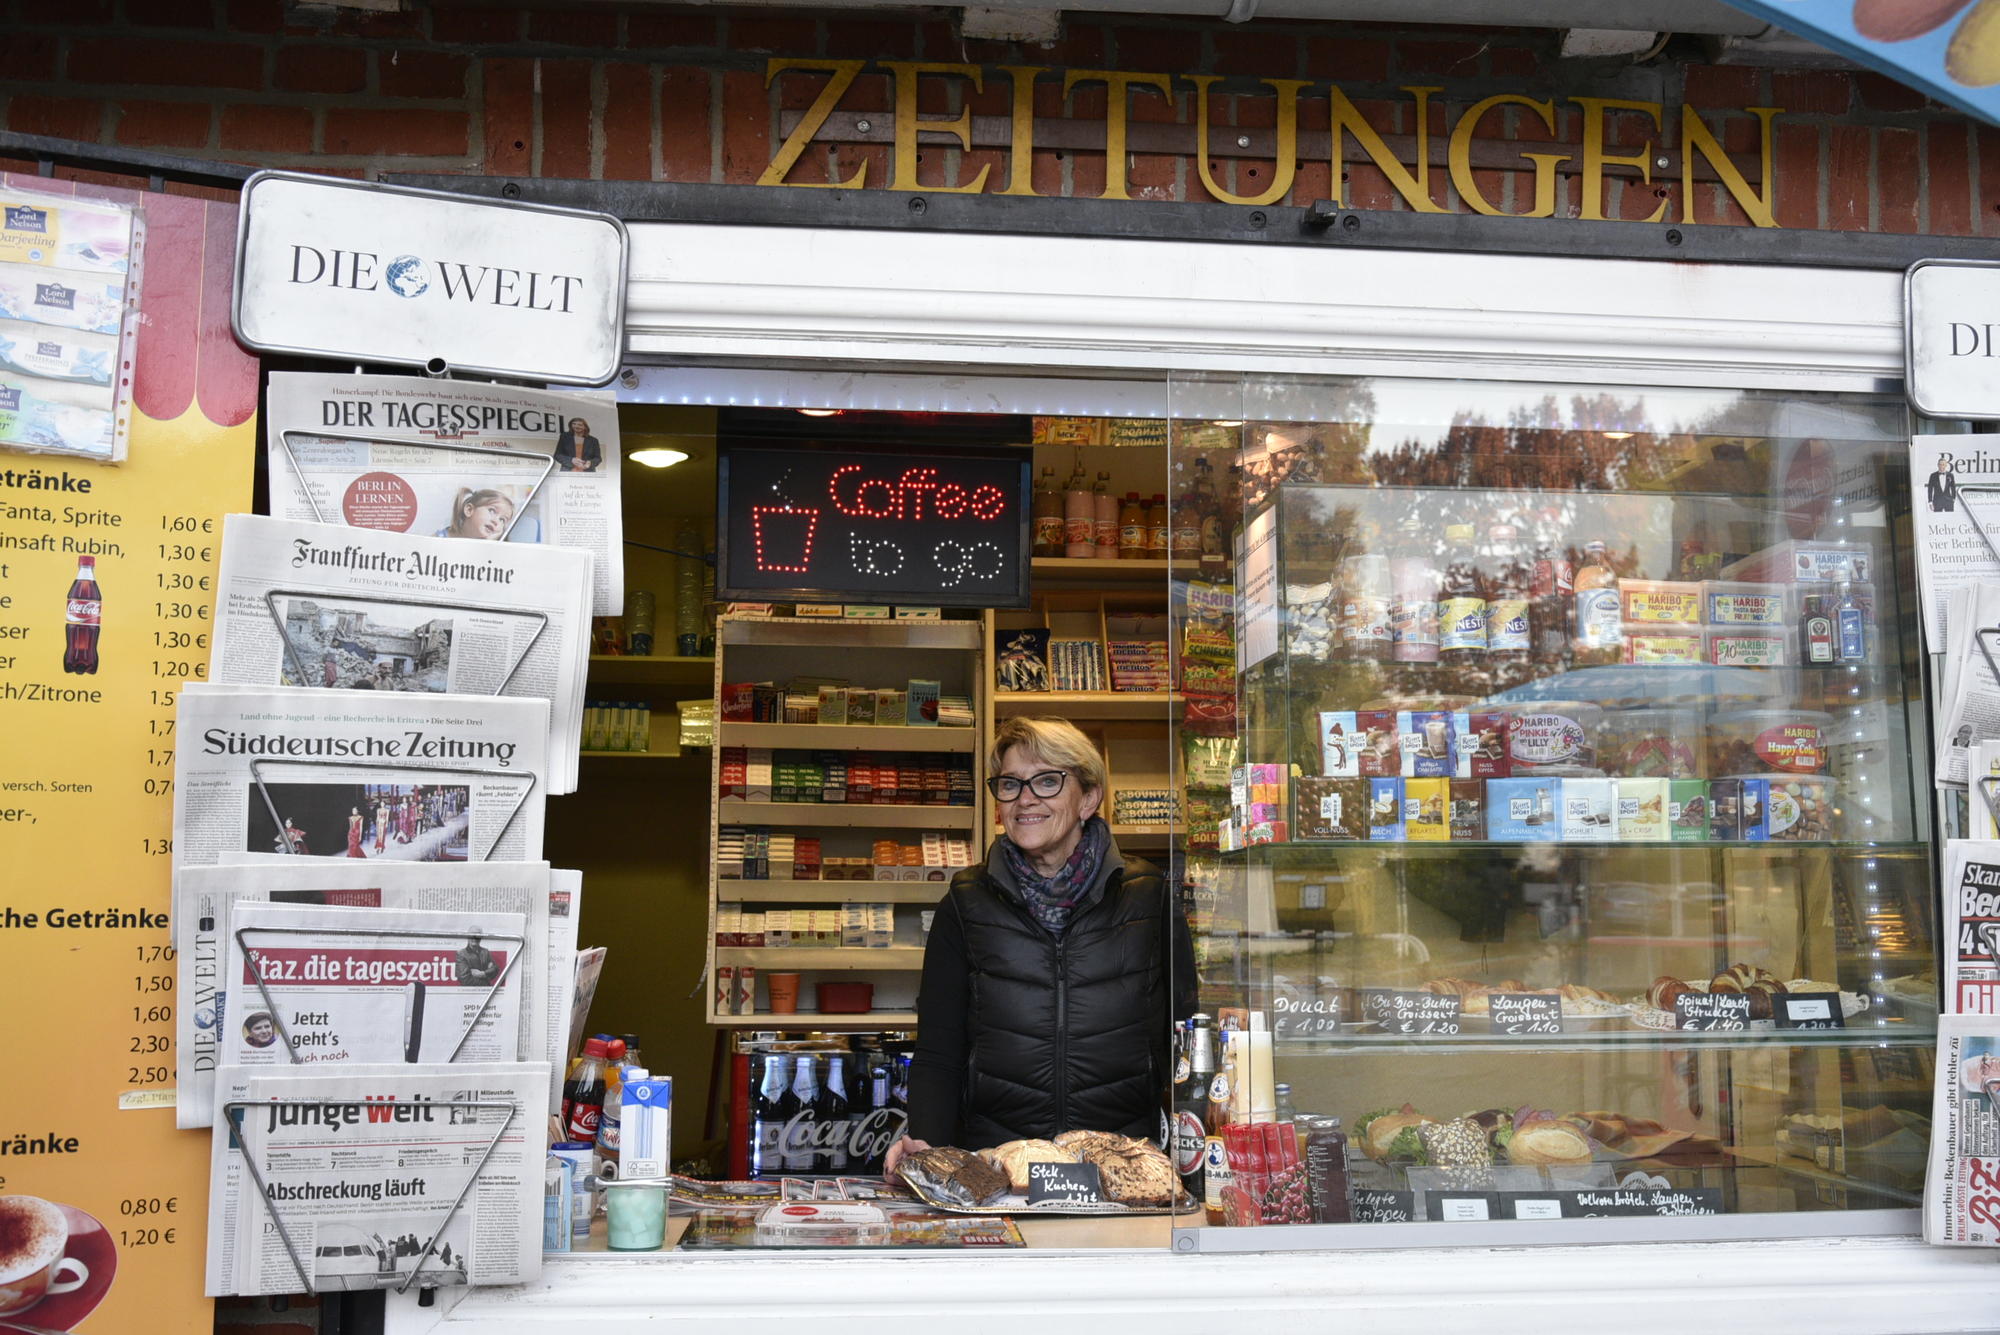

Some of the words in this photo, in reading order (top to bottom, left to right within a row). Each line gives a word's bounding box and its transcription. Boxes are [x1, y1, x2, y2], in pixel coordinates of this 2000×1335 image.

[757, 58, 1782, 229] ZEITUNGEN
[10, 219, 42, 229] Nelson
[15, 212, 37, 220] Lord
[288, 245, 378, 291] DIE
[435, 261, 583, 313] WELT
[40, 294, 70, 306] Nelson
[45, 288, 66, 298] Lord
[322, 400, 374, 427] DER
[382, 402, 566, 434] TAGESSPIEGEL
[358, 480, 401, 491] BERLIN
[829, 465, 1004, 520] Coffee
[355, 493, 404, 504] LERNEN
[63, 506, 122, 531] Sprite
[160, 515, 197, 534] 1,60
[201, 517, 213, 534] €
[1928, 524, 1956, 536] Mehr
[62, 535, 126, 558] Rubin,
[158, 544, 194, 563] 1,30
[200, 546, 212, 562] €
[1929, 538, 1949, 550] vier
[292, 539, 405, 576] Frankfurter
[406, 551, 514, 584] Allgemeine
[849, 531, 904, 576] to
[933, 540, 1003, 587] go
[1815, 554, 1848, 564] HARIBO
[156, 573, 194, 592] 1,30
[198, 575, 210, 591] €
[349, 577, 383, 587] ZEITUNG
[384, 580, 400, 588] FÜR
[401, 582, 457, 593] DEUTSCHLAND
[1192, 590, 1234, 607] HARIB
[1648, 595, 1682, 605] HARIBO
[1733, 597, 1766, 607] HARIBO
[155, 602, 192, 621] 1,30
[197, 604, 209, 620] €
[1506, 620, 1528, 632] NEST
[153, 631, 190, 650] 1,30
[195, 633, 207, 649] €
[1735, 640, 1768, 650] HARIBO
[1188, 645, 1235, 657] SCHNECKE
[152, 660, 189, 680] 1,20
[194, 662, 206, 678] €
[150, 689, 174, 707] 1,5
[149, 718, 175, 736] 1,7
[240, 713, 262, 721] Land
[262, 713, 283, 722] ohne
[285, 713, 315, 724] Jugend
[343, 714, 386, 724] Recherche
[397, 716, 425, 725] Eritrea
[431, 717, 445, 725] Die
[445, 718, 465, 726] Seite
[466, 719, 483, 727] Drei
[1525, 717, 1559, 727] HARIBO
[1520, 728, 1549, 737] PINKIE
[1784, 727, 1816, 738] HARIBO
[202, 728, 401, 757] Süddeutsche
[404, 732, 517, 767] Zeitung
[1528, 738, 1550, 747] LILLY
[1767, 741, 1798, 754] Happy
[147, 749, 174, 768] 1,7
[2, 781, 48, 793] versch.
[50, 781, 93, 793] Sorten
[1127, 790, 1168, 799] BOUNTY
[1129, 809, 1171, 818] BOUNTY
[1452, 829, 1473, 837] NUSS
[46, 907, 168, 929] Getränke
[1959, 922, 1975, 955] 4
[136, 945, 174, 963] 1,70
[194, 934, 217, 1006] WELT
[259, 954, 341, 981] taz.die
[345, 956, 458, 984] tageszeitu
[134, 975, 172, 993] 1,50
[133, 1006, 171, 1024] 1,60
[292, 1011, 329, 1026] Jetzt
[1397, 1009, 1457, 1020] Croissant
[1495, 1011, 1559, 1023] Croissant
[1685, 1003, 1739, 1020] Strudel
[1401, 1021, 1415, 1033] €
[1506, 1025, 1521, 1035] €
[1682, 1019, 1699, 1031] €
[130, 1036, 170, 1054] 2,30
[194, 1032, 216, 1073] DIE
[321, 1049, 350, 1061] noch
[128, 1066, 168, 1085] 2,50
[1946, 1052, 1959, 1087] Fehler
[1947, 1087, 1959, 1109] gibt
[267, 1097, 361, 1134] junge
[366, 1093, 434, 1124] Welt
[778, 1107, 909, 1159] Coca-Col
[1944, 1111, 1957, 1181] Beckenbauer
[266, 1162, 272, 1172] 3
[330, 1161, 337, 1170] 7
[398, 1158, 404, 1167] 8
[463, 1156, 470, 1165] 11
[1031, 1164, 1064, 1179] Stck.
[1957, 1157, 1968, 1184] ZEITUNG
[266, 1180, 382, 1201] Abschreckung
[385, 1178, 426, 1197] läuft
[1044, 1180, 1089, 1193] Kuchen
[121, 1199, 161, 1216] 0,80
[166, 1197, 178, 1213] €
[1353, 1192, 1397, 1211] belegte
[1956, 1185, 1967, 1213] GRÖSSTE
[1943, 1182, 1954, 1242] Immerhin:
[1956, 1214, 1967, 1242] BERLINS
[121, 1229, 160, 1247] 1,20
[164, 1228, 176, 1244] €
